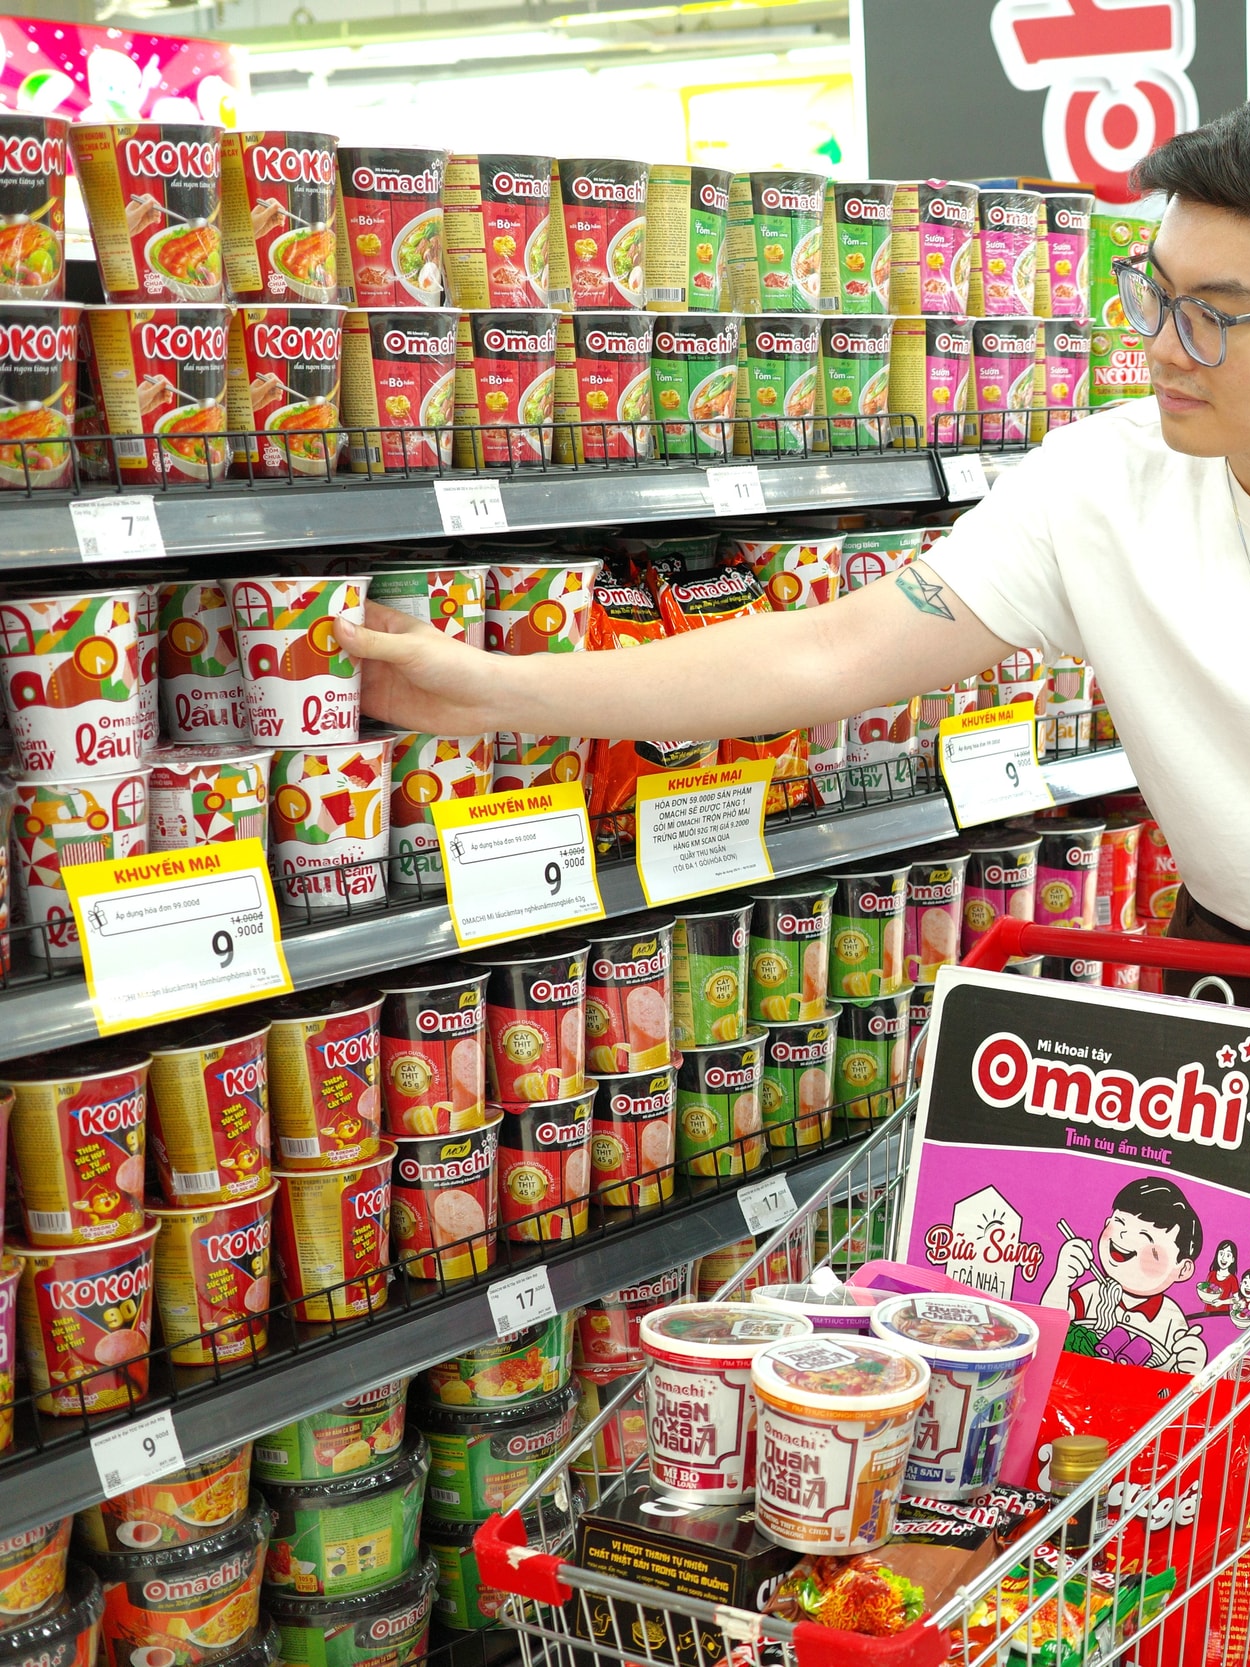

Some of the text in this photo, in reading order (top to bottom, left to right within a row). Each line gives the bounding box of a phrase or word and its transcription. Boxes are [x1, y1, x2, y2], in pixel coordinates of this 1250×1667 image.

[142, 324, 226, 360] KOKO
[656, 332, 732, 354] Omachi
[735, 483, 750, 498] 11
[469, 498, 489, 517] 11
[121, 516, 134, 537] 7
[669, 769, 742, 791] KHUYẾN MẠI
[1006, 762, 1019, 787] 9
[469, 795, 552, 819] KHUYẾN MẠI
[655, 800, 670, 810] HÓA
[672, 796, 688, 806] ĐƠN
[659, 808, 687, 820] OMACHI
[653, 822, 666, 832] GÓI
[677, 818, 701, 828] OMACHI
[738, 807, 750, 815] MAI
[515, 834, 536, 842] 99.000đ
[702, 836, 717, 845] SCAN
[718, 833, 730, 842] QUA
[697, 848, 709, 857] THU
[114, 854, 221, 884] KHUYẾN MẠI
[545, 862, 562, 896] 9
[173, 899, 200, 910] 99.000đ
[462, 916, 486, 925] OMACHI
[212, 930, 234, 969] 9
[1038, 1039, 1113, 1065] Mì khoai tây
[977, 1037, 1247, 1144] Omachi
[80, 1095, 145, 1136] KOKO
[1065, 1127, 1091, 1148] Tinh
[1094, 1132, 1116, 1154] túy
[1118, 1137, 1139, 1158] ẩm
[400, 1147, 490, 1181] Omachi
[763, 1192, 778, 1211] 17
[927, 1225, 1042, 1279] Bữa Sáng
[976, 1268, 999, 1291] NHÀ
[516, 1288, 534, 1310] 17
[104, 1299, 137, 1328] 90
[655, 1375, 704, 1398] Omachi
[764, 1421, 816, 1450] Omachi
[142, 1437, 156, 1458] 9
[677, 1479, 697, 1489] LOAN
[771, 1524, 804, 1540] HONGKONG
[809, 1527, 829, 1536] CHUA
[645, 1549, 670, 1563] THANH
[651, 1563, 677, 1578] TRONG
